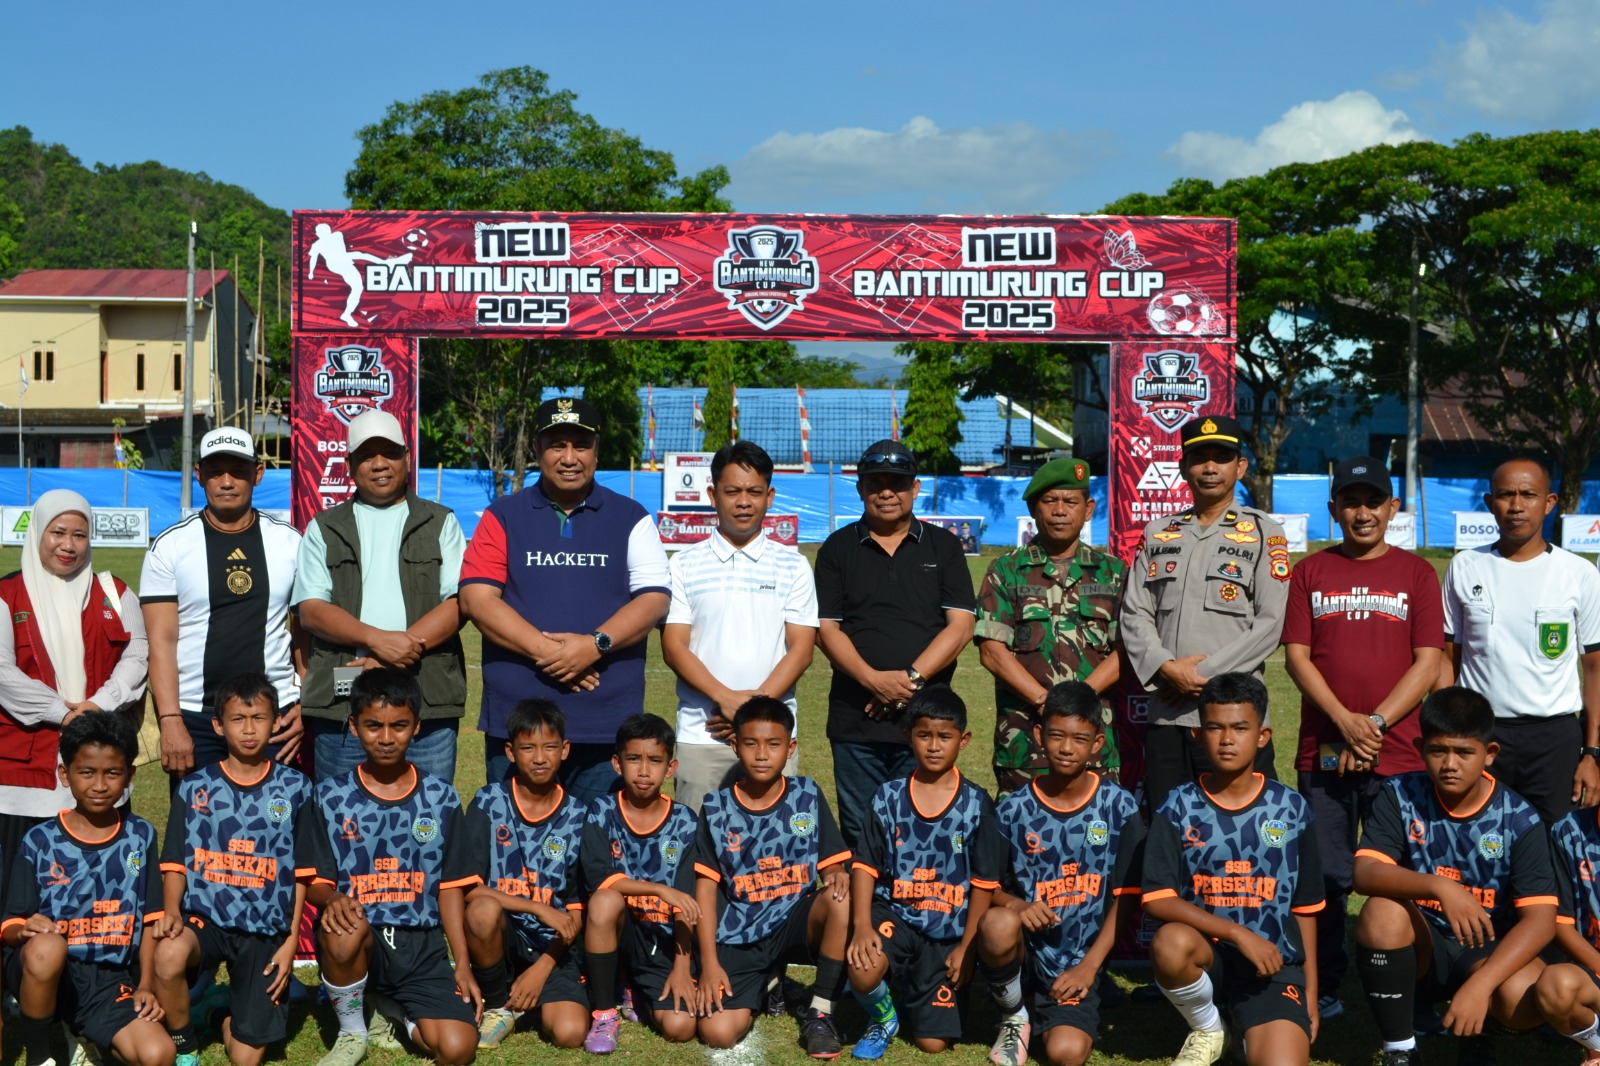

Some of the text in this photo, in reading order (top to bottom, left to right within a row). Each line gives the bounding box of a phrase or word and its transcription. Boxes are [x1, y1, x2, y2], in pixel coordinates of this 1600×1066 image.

[481, 228, 568, 257] NEW
[969, 233, 1051, 262] NEW
[366, 266, 680, 294] BANTIMURUNG CUP
[721, 263, 812, 286] BANTIMURUNG
[756, 281, 776, 289] CUP
[854, 270, 1164, 297] BANTIMURUNG CUP
[479, 299, 569, 324] 2025
[964, 303, 1054, 328] 2025
[319, 374, 388, 393] BANTIMURUNG
[1137, 379, 1205, 398] BANTIMURUNG
[207, 436, 246, 448] adidas
[318, 441, 347, 452] BOS
[1140, 490, 1190, 498] APPARE
[96, 514, 140, 532] BSP
[526, 551, 608, 566] HACKETT
[1218, 546, 1253, 562] POLRI
[1352, 587, 1369, 595] NEW
[1312, 591, 1408, 621] BANTIMURUNG
[1347, 612, 1370, 620] CUP
[228, 838, 255, 853] SSB
[194, 848, 277, 881] PERSEKAB
[374, 857, 399, 870] SSB
[758, 856, 782, 870] SSB
[1062, 862, 1079, 876] SS
[1225, 861, 1251, 874] SSB
[733, 863, 810, 897] PERSEKAB
[913, 868, 936, 881] SSB
[893, 880, 965, 907] ERSEKAB
[1193, 874, 1277, 901] PERSEKAB
[93, 899, 120, 913] SSB
